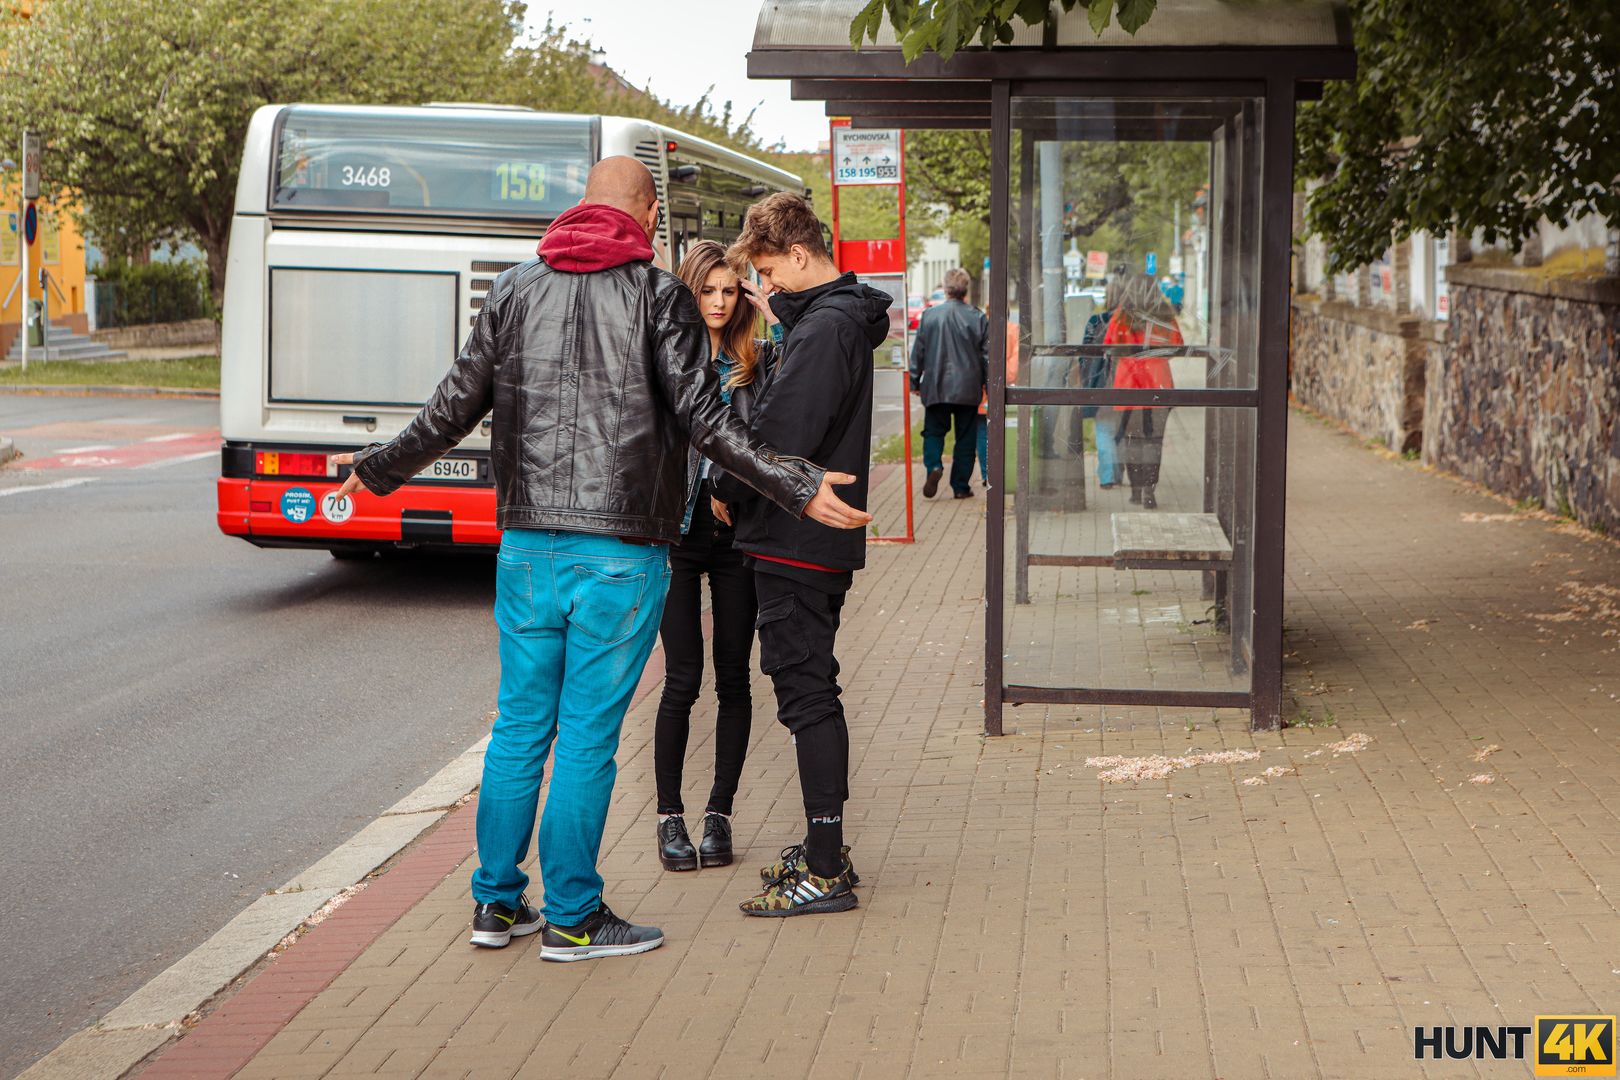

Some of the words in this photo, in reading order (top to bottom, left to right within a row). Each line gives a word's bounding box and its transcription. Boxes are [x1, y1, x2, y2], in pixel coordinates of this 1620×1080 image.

[843, 132, 890, 141] RYCHNOVSKÁ
[341, 165, 391, 187] 3468
[840, 168, 857, 178] 158
[859, 167, 876, 177] 195
[496, 162, 545, 200] 158
[434, 461, 470, 477] 6940
[328, 496, 347, 512] 70
[812, 815, 841, 824] FILA
